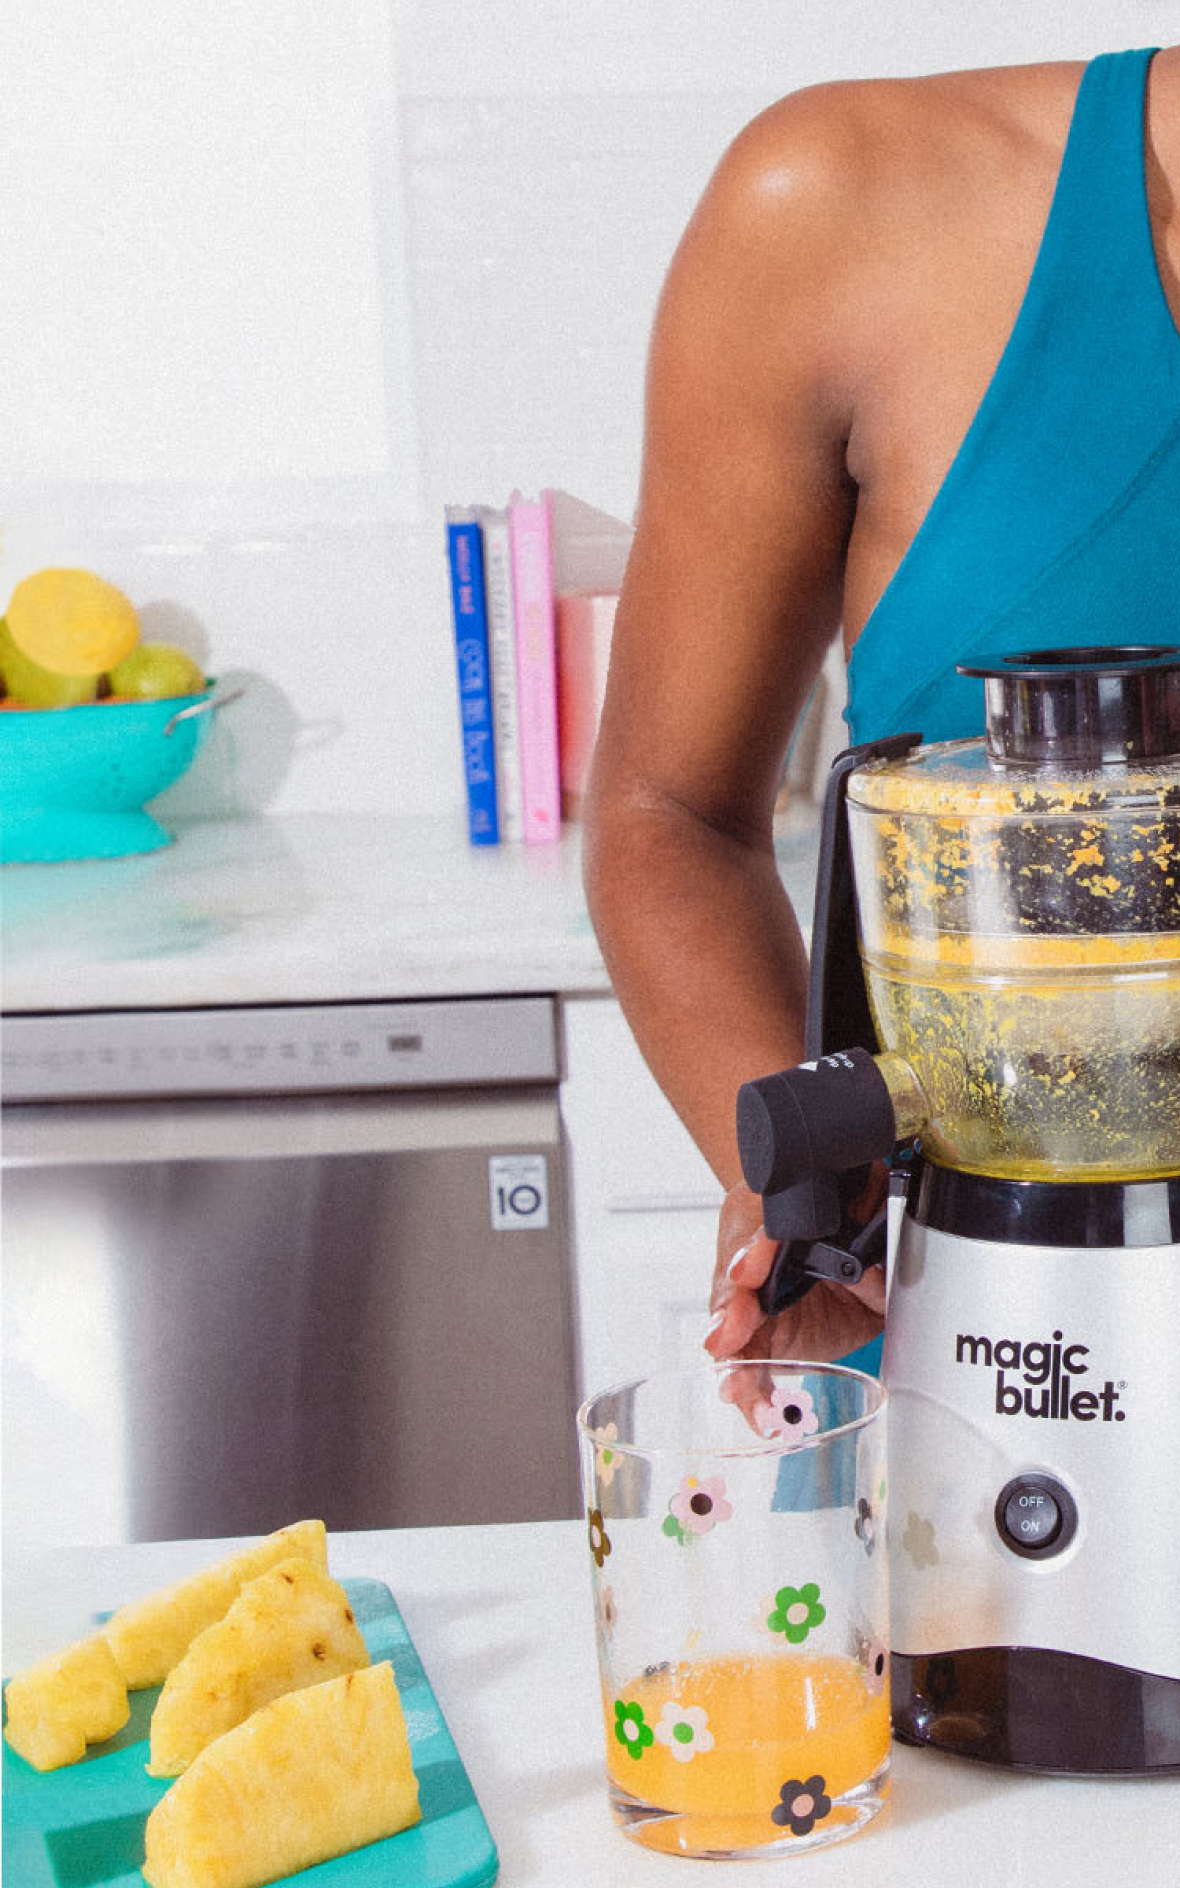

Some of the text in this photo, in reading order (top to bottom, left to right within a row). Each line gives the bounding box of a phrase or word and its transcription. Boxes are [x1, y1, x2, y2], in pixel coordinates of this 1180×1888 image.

[956, 1330, 1090, 1386] magic
[1019, 1496, 1044, 1508] OFF
[1020, 1520, 1039, 1532] ON
